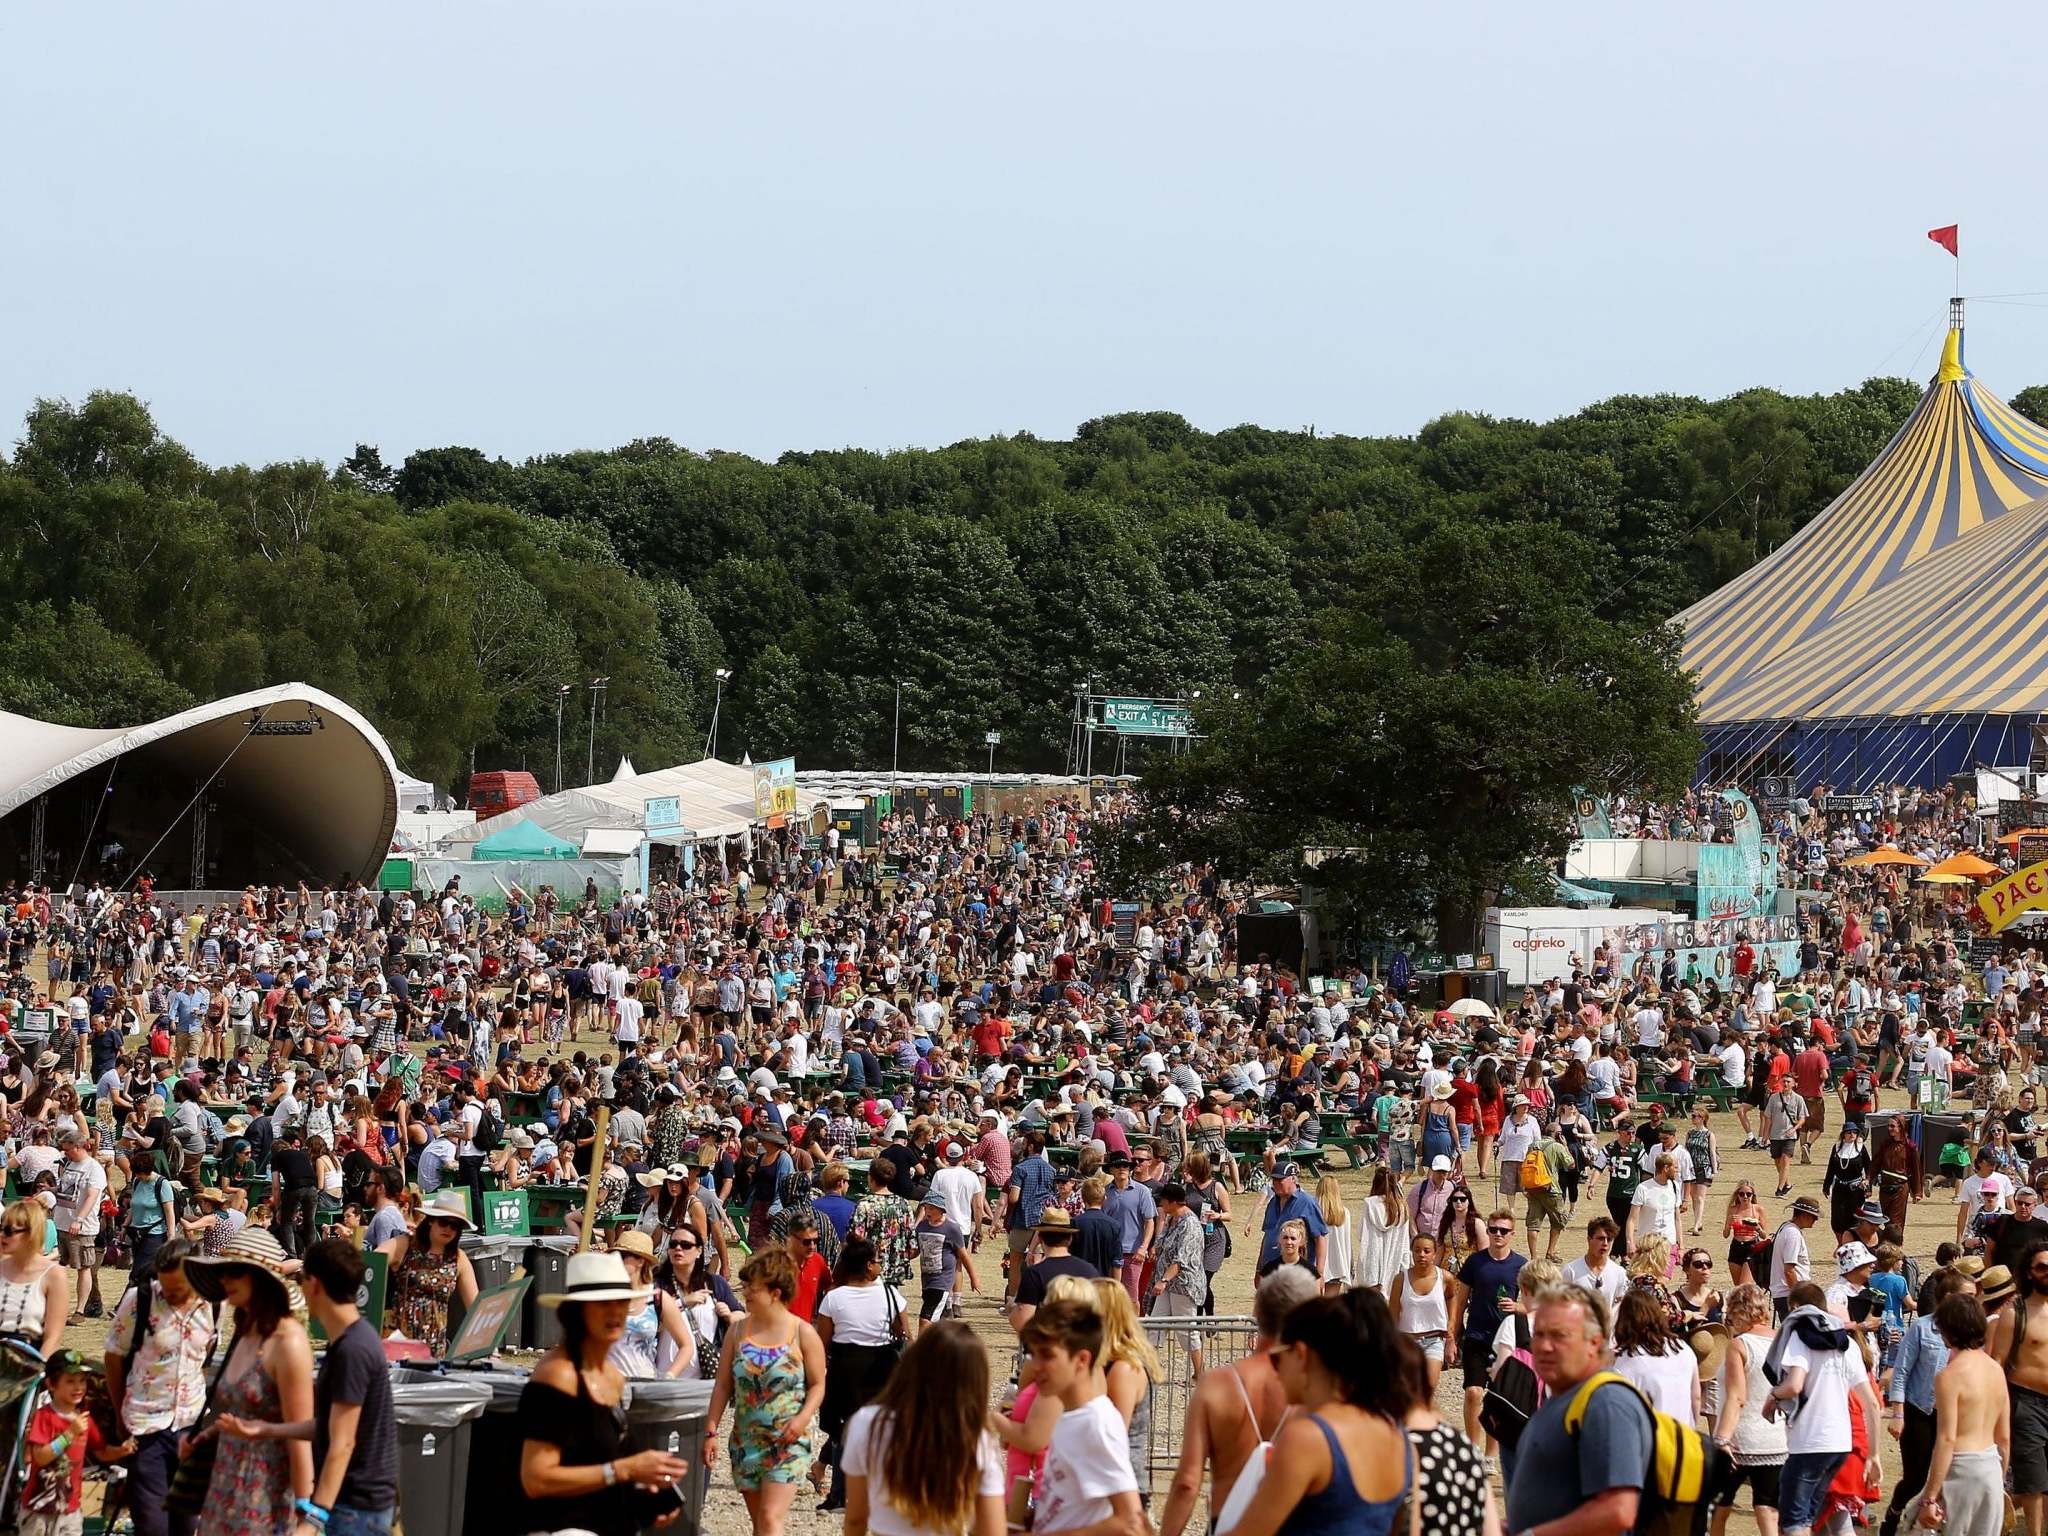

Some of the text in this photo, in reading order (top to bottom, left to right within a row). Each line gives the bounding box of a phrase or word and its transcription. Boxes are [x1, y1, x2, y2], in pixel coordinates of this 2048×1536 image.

[1117, 704, 1151, 712] EMERGENCY
[1118, 711, 1138, 721] EXIT
[1140, 713, 1148, 721] A
[1710, 893, 1754, 914] Coffee
[1513, 936, 1566, 952] aggreko
[1611, 1156, 1633, 1179] 15
